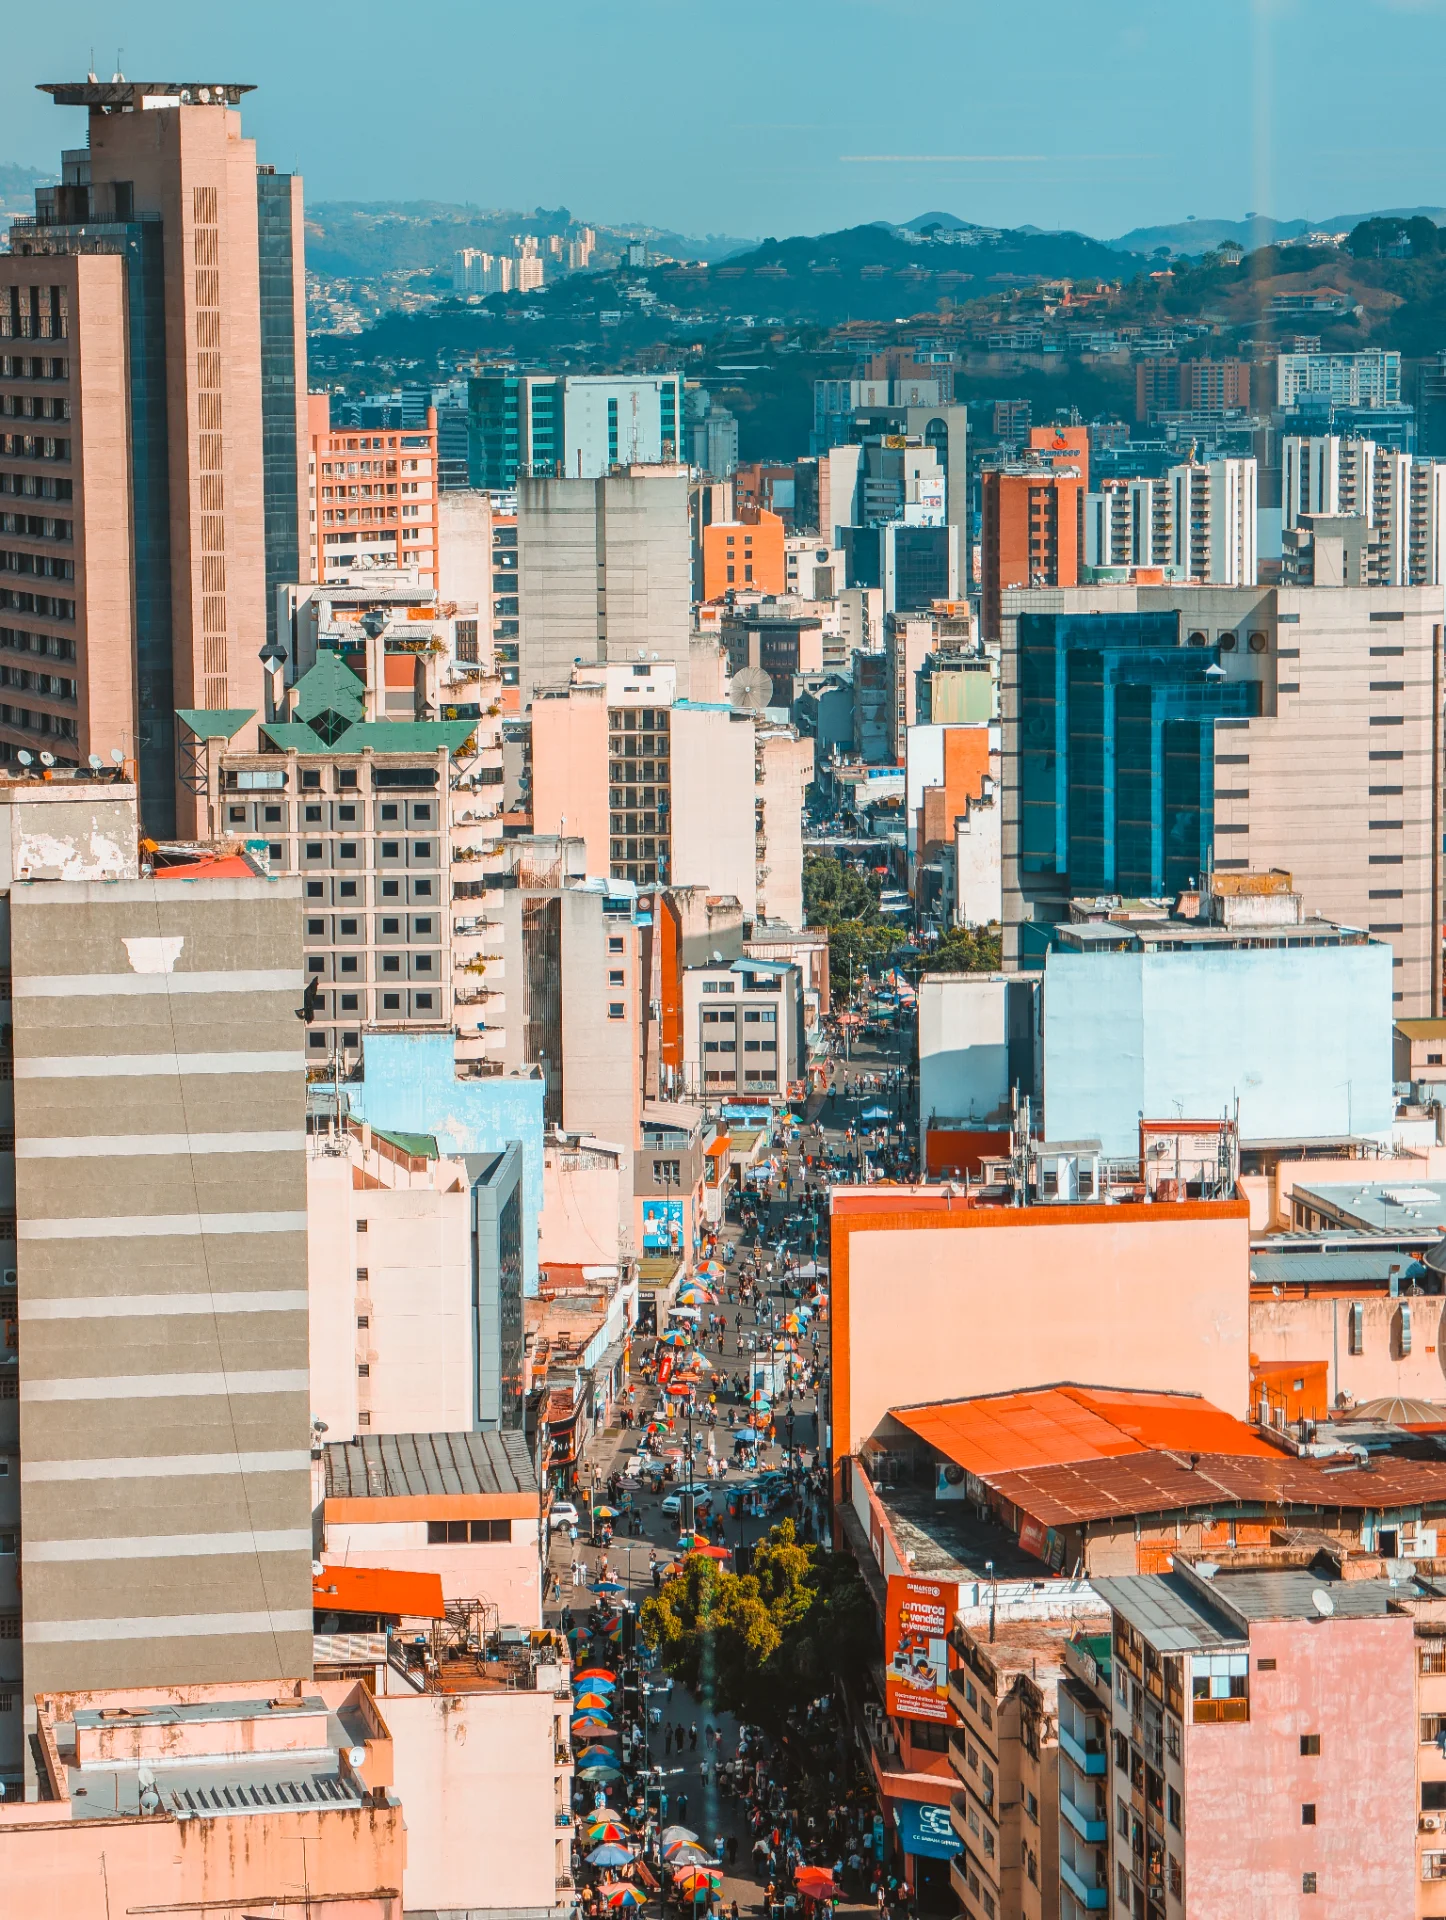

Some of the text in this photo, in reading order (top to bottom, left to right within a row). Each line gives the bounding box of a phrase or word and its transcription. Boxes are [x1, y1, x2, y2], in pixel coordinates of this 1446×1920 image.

[1039, 449, 1080, 457] Banesco
[902, 1601, 945, 1615] La marca
[910, 1613, 944, 1626] vendida
[909, 1622, 944, 1634] Venezuela
